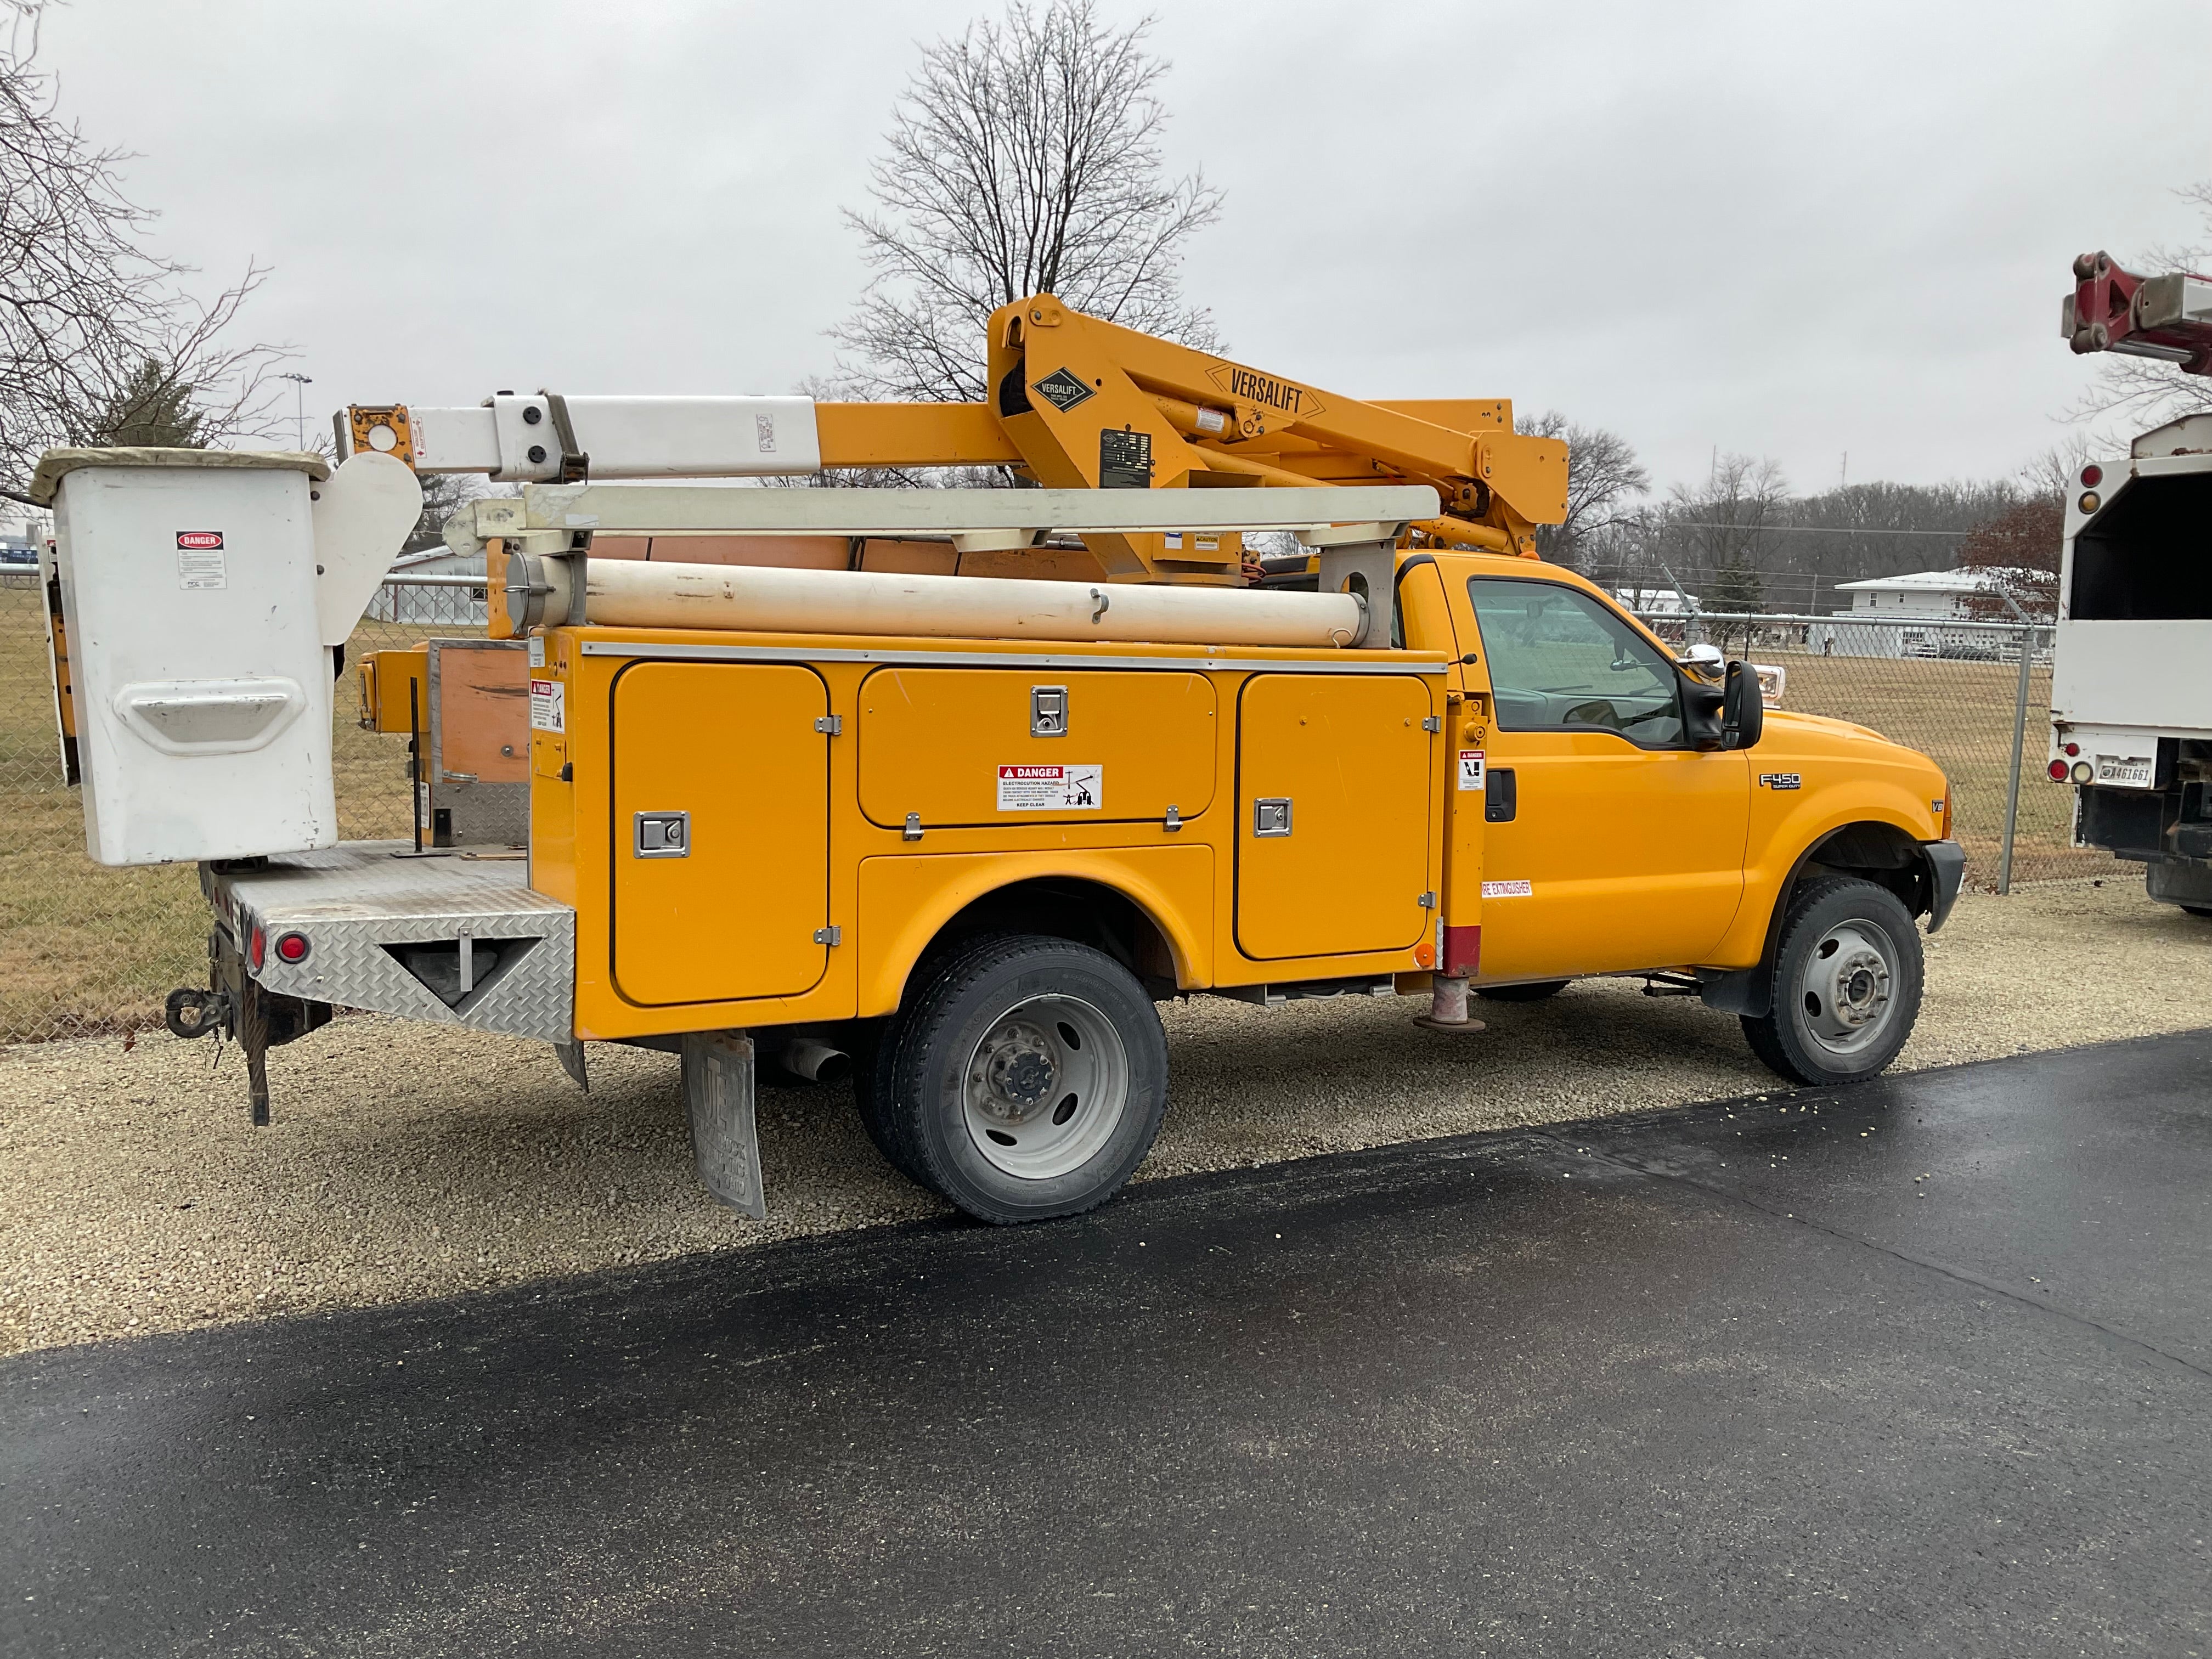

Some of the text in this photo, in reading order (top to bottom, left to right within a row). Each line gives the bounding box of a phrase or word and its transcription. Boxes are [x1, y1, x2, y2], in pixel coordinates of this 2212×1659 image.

[1042, 383, 1076, 395] VERSALIFT
[1232, 368, 1302, 413] VERSALIFT
[1017, 768, 1059, 777] DANGER
[1933, 803, 1943, 812] V8
[1492, 882, 1530, 895] EXTINGUISHER
[702, 1056, 727, 1132] UTE
